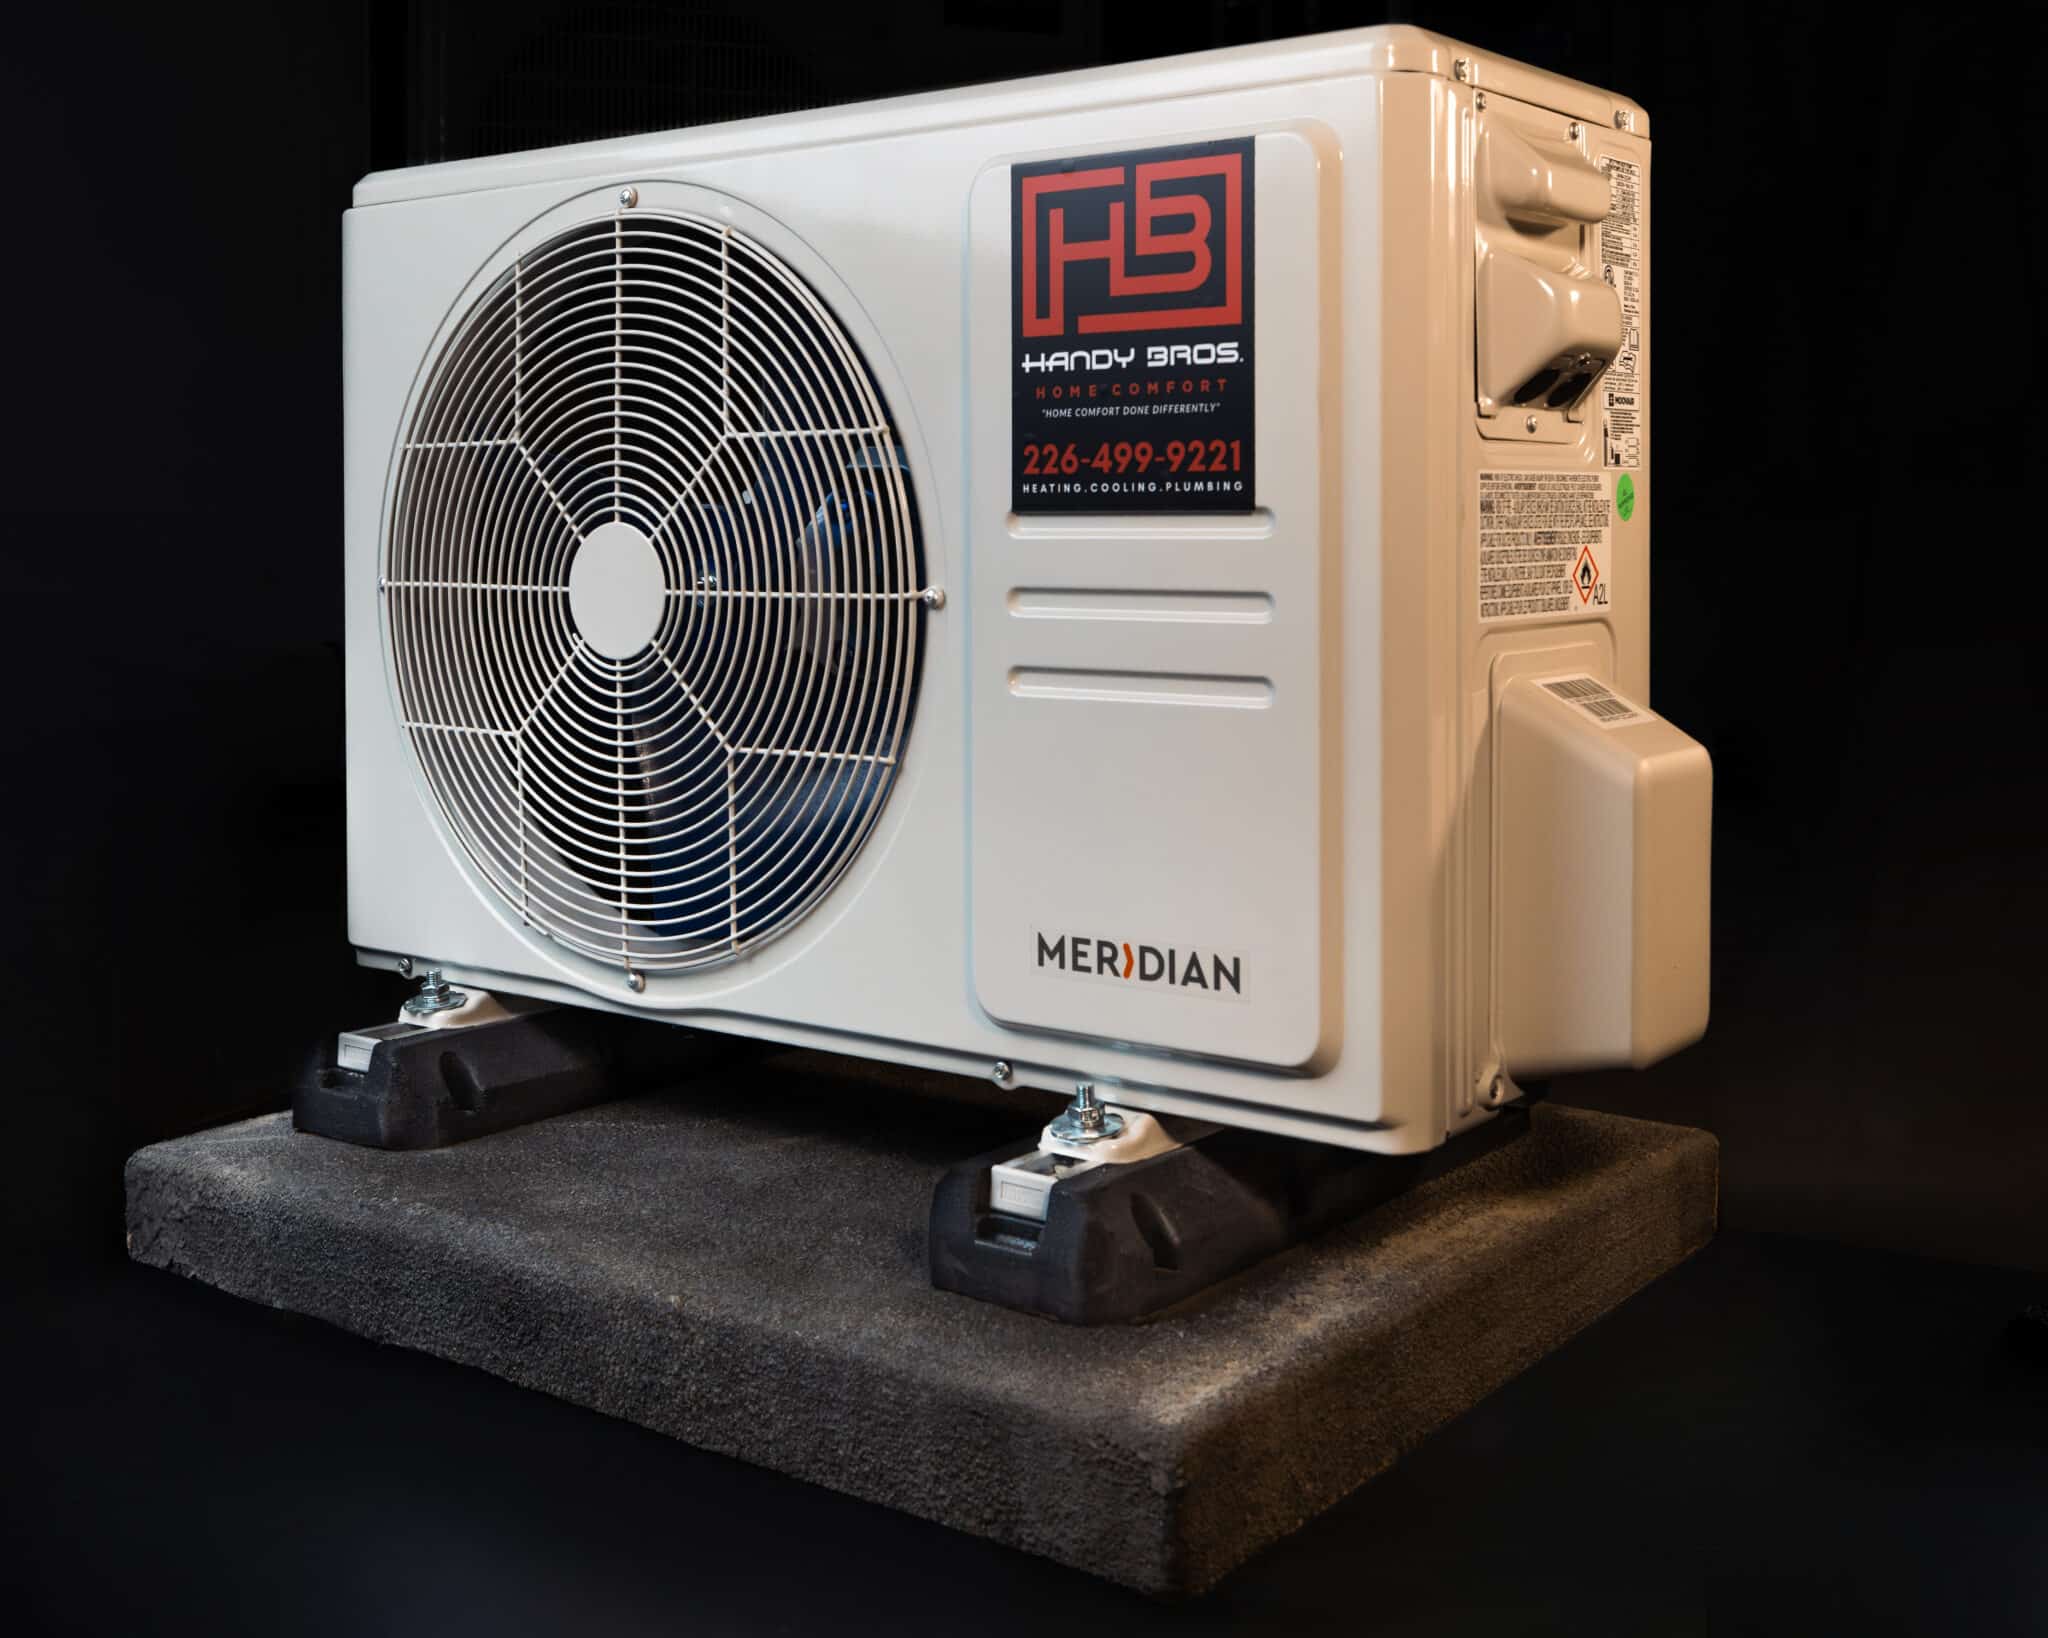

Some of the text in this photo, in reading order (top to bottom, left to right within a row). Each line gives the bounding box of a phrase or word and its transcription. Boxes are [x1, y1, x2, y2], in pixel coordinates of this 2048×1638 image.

[1021, 342, 1245, 373] HANDY BROS.
[1035, 378, 1228, 400] HOME COMFORT
[1042, 402, 1221, 419] "HOME COMFORT DONE DIFFERENTLY"
[1022, 439, 1242, 476] 226-499-9221
[1592, 583, 1609, 606] A2L
[1037, 931, 1241, 995] MERIDIAN
